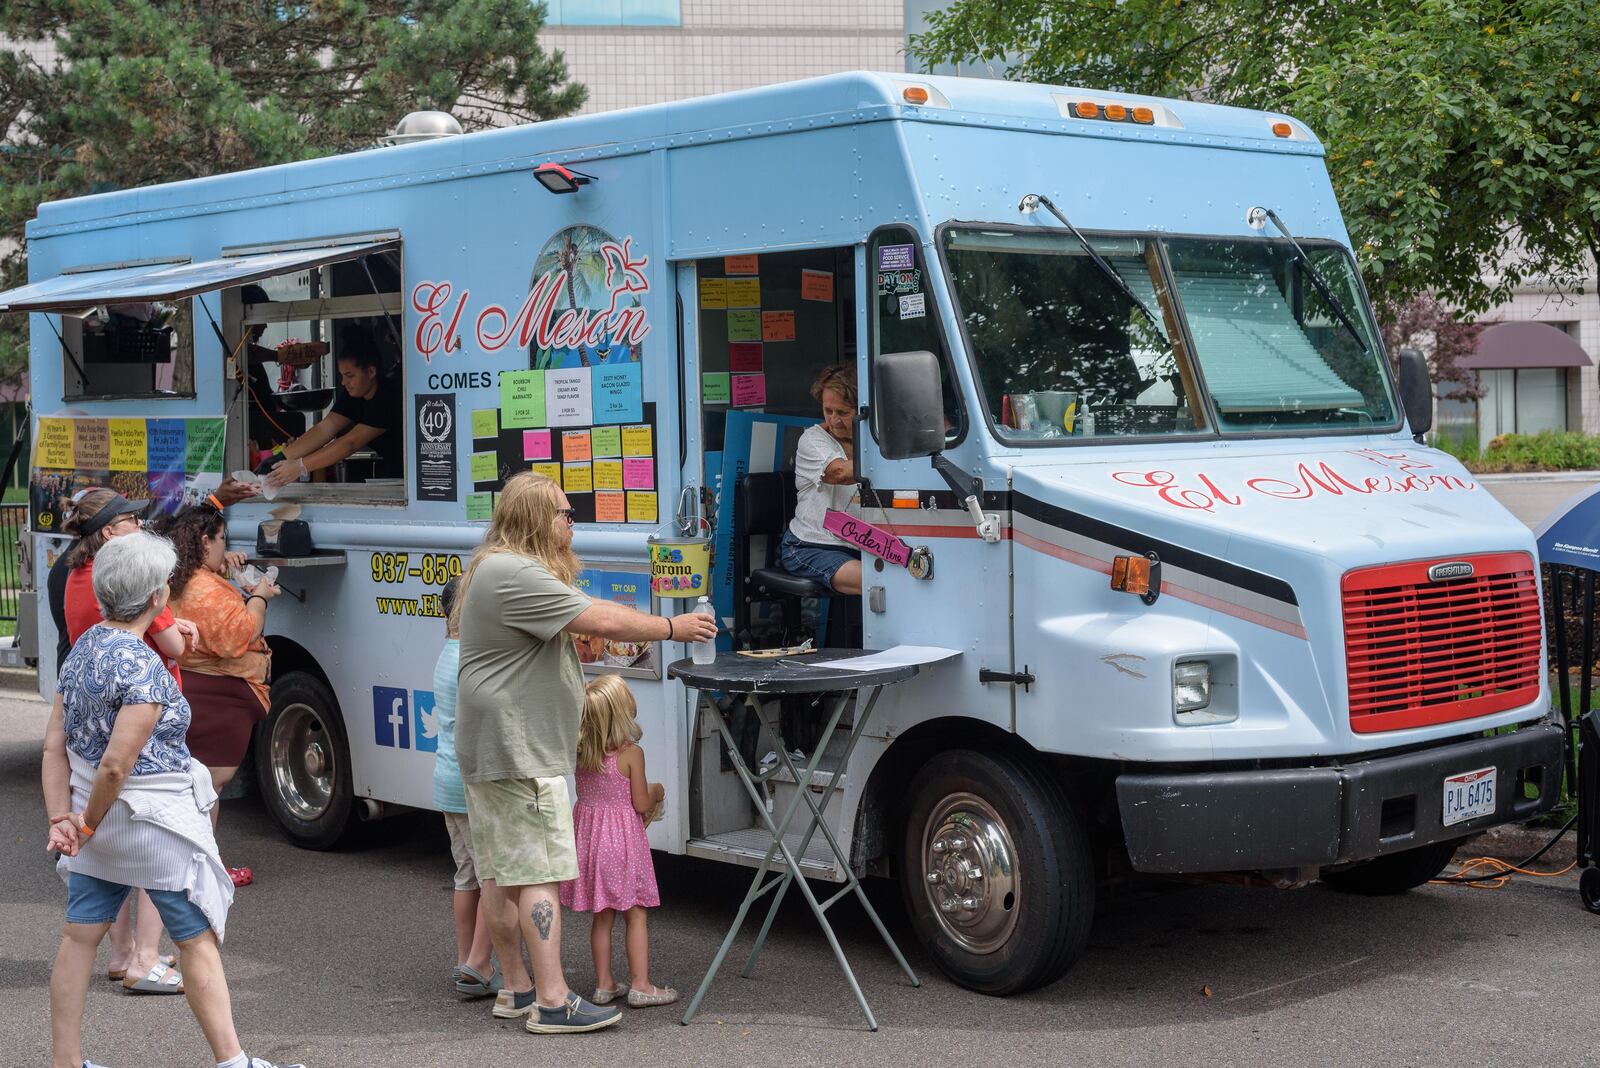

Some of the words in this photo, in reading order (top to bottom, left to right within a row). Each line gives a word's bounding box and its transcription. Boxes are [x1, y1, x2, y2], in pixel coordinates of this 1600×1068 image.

[878, 272, 913, 285] DAYTON
[412, 280, 468, 364] El
[428, 371, 492, 390] COMES
[134, 430, 145, 438] Party
[421, 442, 452, 451] ANNIVERSARY
[1111, 470, 1241, 512] El
[841, 521, 881, 553] Order
[882, 536, 904, 563] Here
[651, 560, 692, 576] Corona
[1436, 565, 1472, 576] FREIGHTLINER
[612, 584, 622, 592] TRY
[623, 585, 636, 593] OUR
[1465, 774, 1477, 783] OHIO
[1448, 788, 1465, 814] PJL
[1468, 780, 1492, 807] 6475
